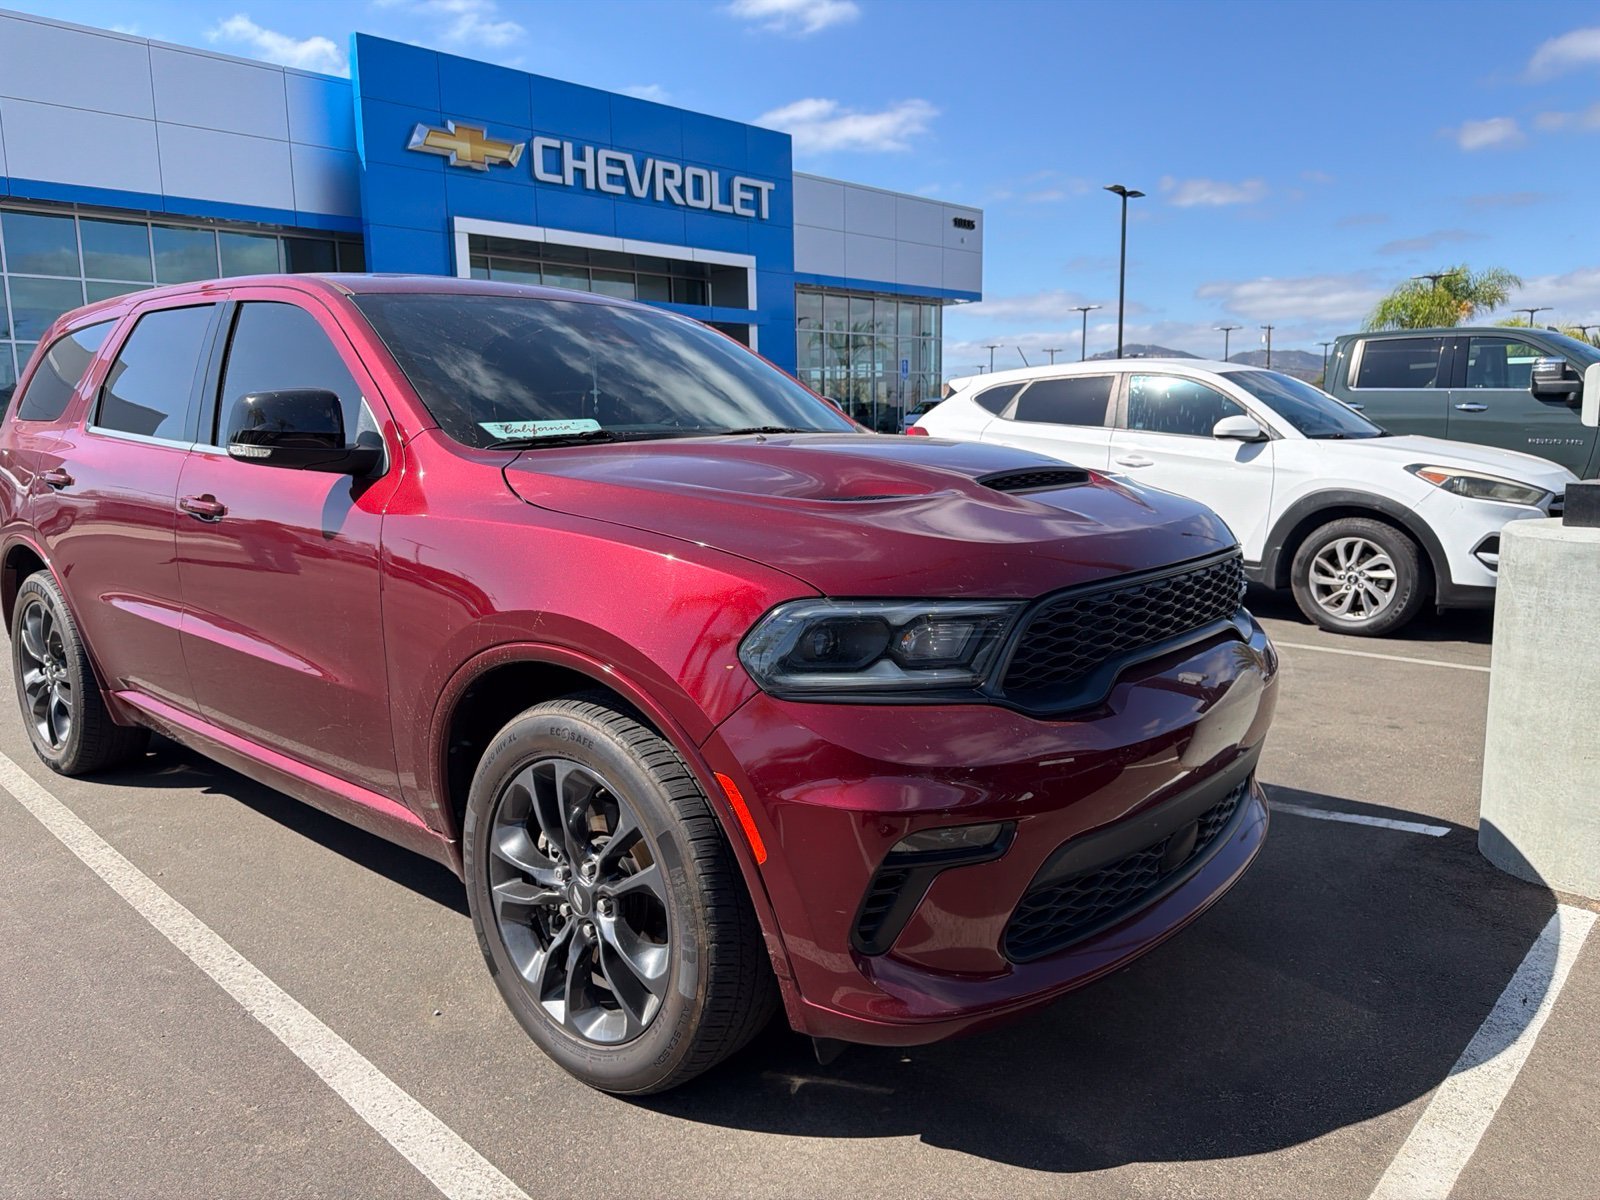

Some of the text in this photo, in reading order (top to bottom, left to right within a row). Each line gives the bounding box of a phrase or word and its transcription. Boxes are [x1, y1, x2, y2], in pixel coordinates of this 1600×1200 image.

[530, 135, 775, 220] CHEVROLET
[504, 423, 571, 435] California
[550, 727, 594, 750] ECOSAFE
[653, 1030, 682, 1068] SEASON
